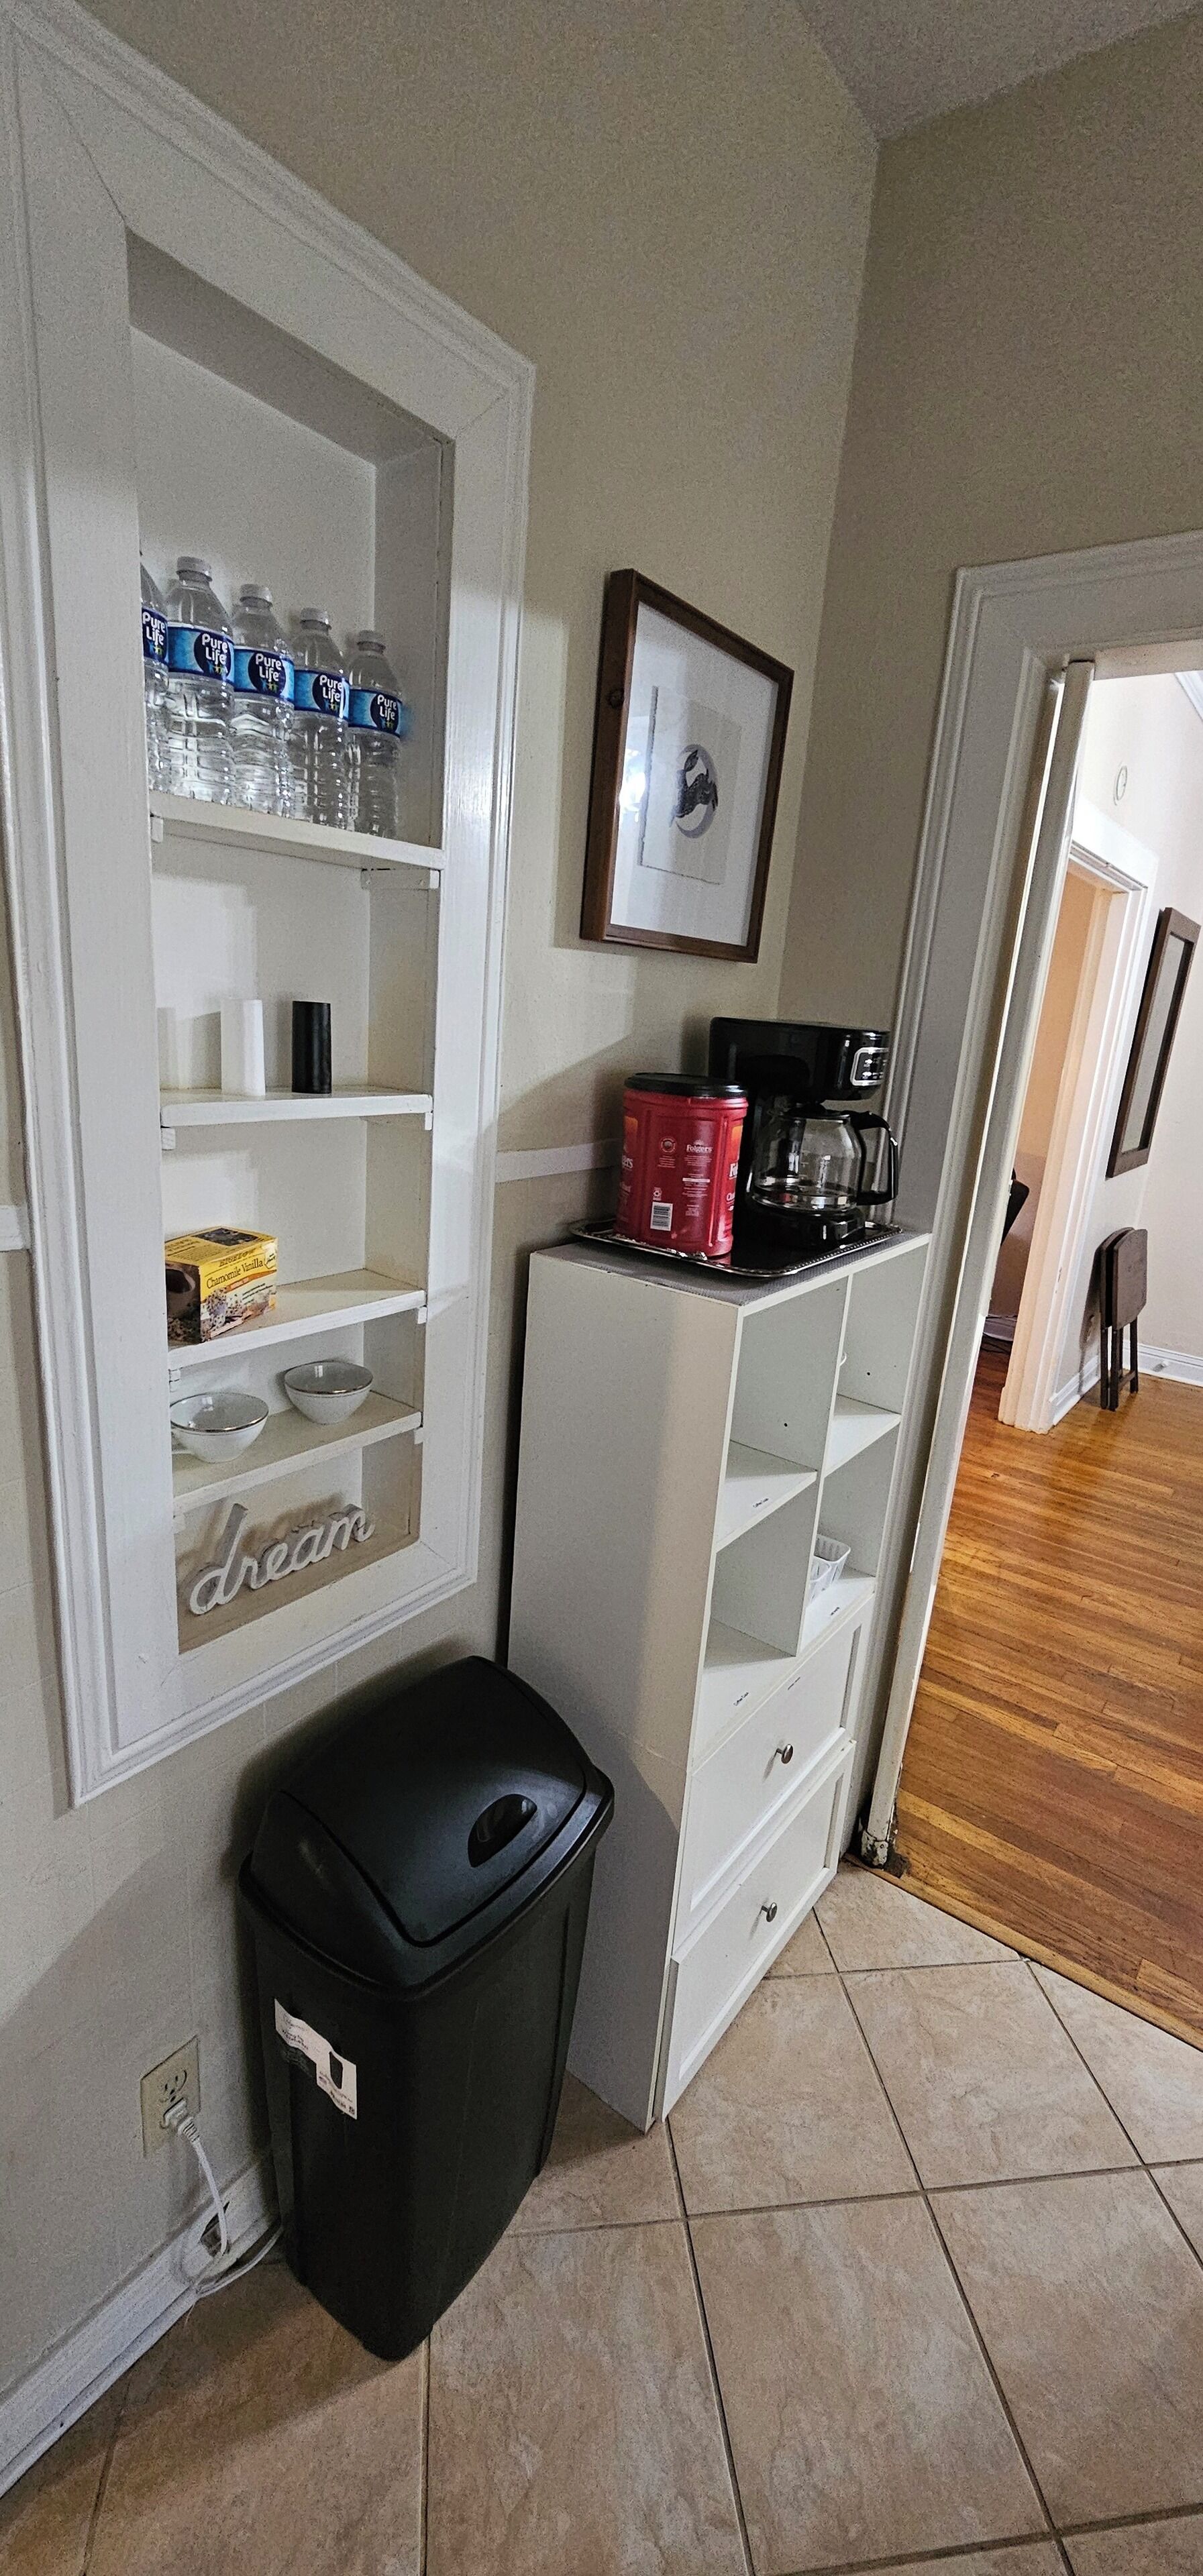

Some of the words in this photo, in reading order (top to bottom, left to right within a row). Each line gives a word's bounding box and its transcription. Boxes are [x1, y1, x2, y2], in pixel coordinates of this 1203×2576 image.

[142, 611, 166, 633] Pure
[146, 626, 165, 646] Life
[202, 633, 228, 653] Pure
[205, 647, 227, 665] Life
[256, 653, 282, 670] Pure
[259, 666, 280, 682] Life
[319, 675, 343, 690] Pure
[322, 687, 341, 702] Life
[377, 694, 397, 711] Pure
[379, 706, 396, 721] Life
[686, 1144, 713, 1153] Folgers
[206, 1266, 242, 1289] Chamomile
[242, 1258, 264, 1273] Vanilla
[189, 1503, 375, 1615] dream
